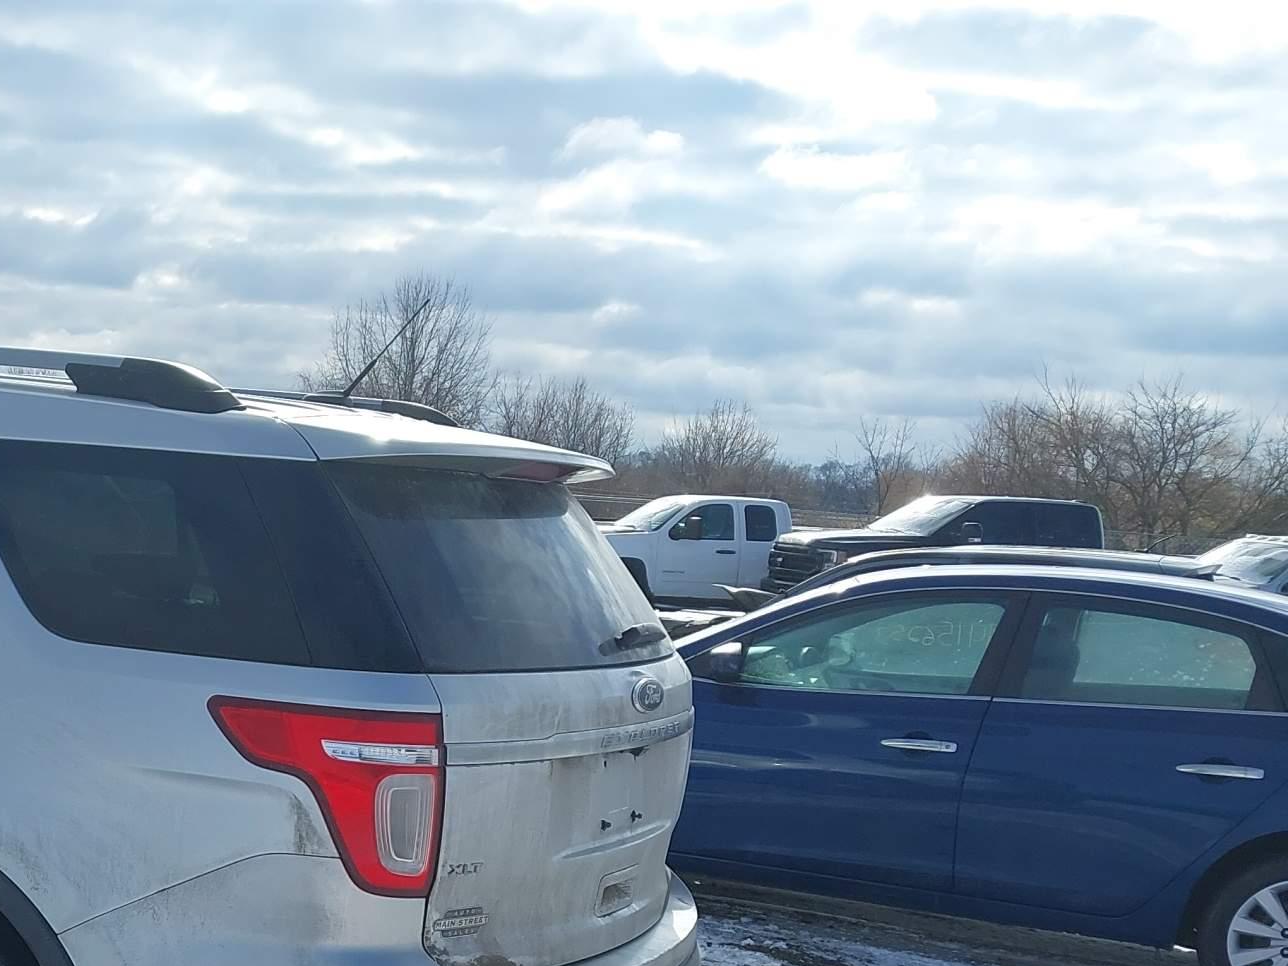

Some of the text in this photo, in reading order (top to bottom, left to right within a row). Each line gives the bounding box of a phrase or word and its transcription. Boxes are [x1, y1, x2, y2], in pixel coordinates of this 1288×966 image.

[448, 863, 484, 875] XLT
[435, 915, 488, 930] MAIN STREET
